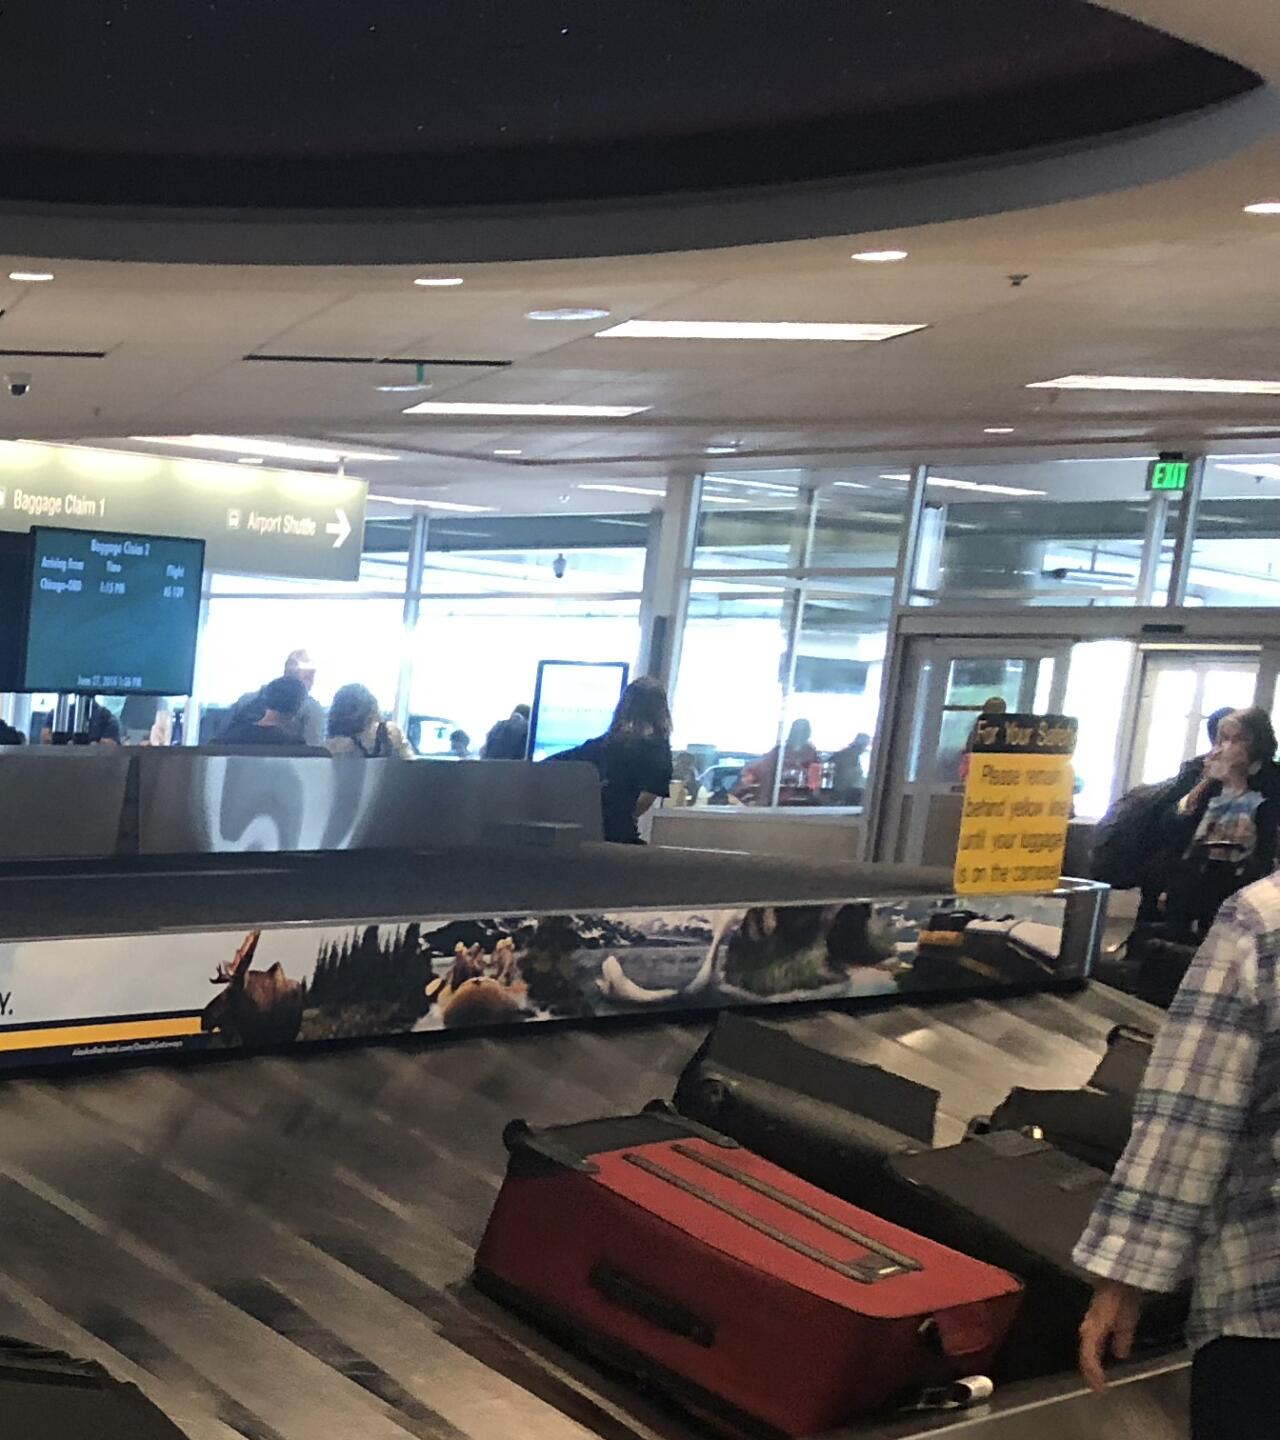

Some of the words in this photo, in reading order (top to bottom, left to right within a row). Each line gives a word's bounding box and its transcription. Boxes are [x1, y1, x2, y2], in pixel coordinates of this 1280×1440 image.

[1152, 463, 1189, 488] EXIT
[13, 489, 61, 516] Baggage
[65, 494, 96, 516] Claim
[99, 496, 107, 517] 1
[247, 511, 282, 536] Airport
[282, 514, 317, 536] Shuttle
[977, 720, 1000, 745] For
[1004, 721, 1033, 746] Your
[982, 764, 1020, 786] Please
[1025, 770, 1062, 786] remain
[965, 797, 1006, 818] behind
[1009, 797, 1043, 821] yellow
[991, 833, 1017, 853] your
[971, 867, 986, 884] on
[990, 864, 1009, 883] the
